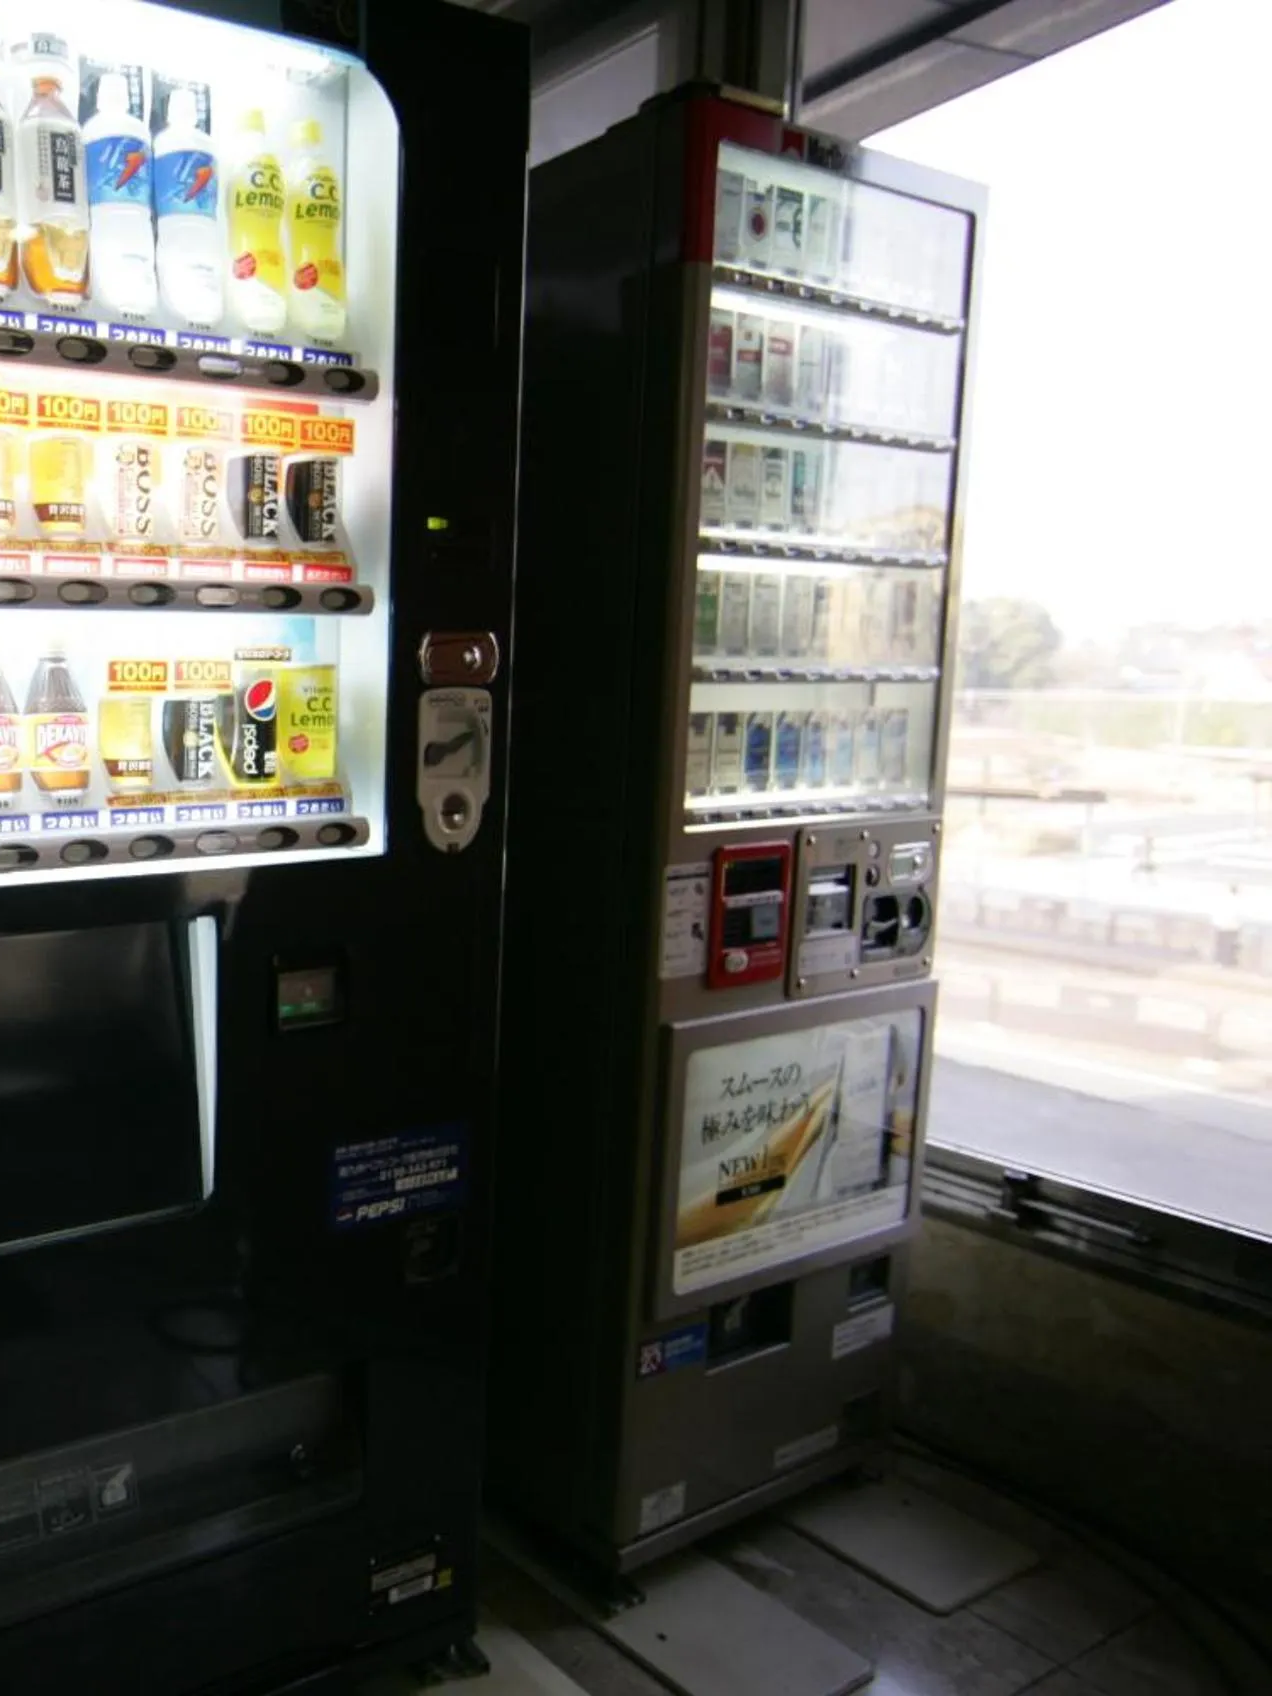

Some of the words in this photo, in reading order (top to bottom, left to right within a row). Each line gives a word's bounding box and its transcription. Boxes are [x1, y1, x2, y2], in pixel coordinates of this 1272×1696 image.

[42, 396, 98, 421] 100円
[112, 403, 165, 425] 100円
[183, 408, 231, 432] 100
[246, 415, 294, 439] 100円
[304, 422, 351, 443] 100円
[113, 662, 165, 681] 100円
[197, 701, 215, 779] BLACK
[242, 724, 259, 775] pepsi
[45, 815, 97, 829] つめたい
